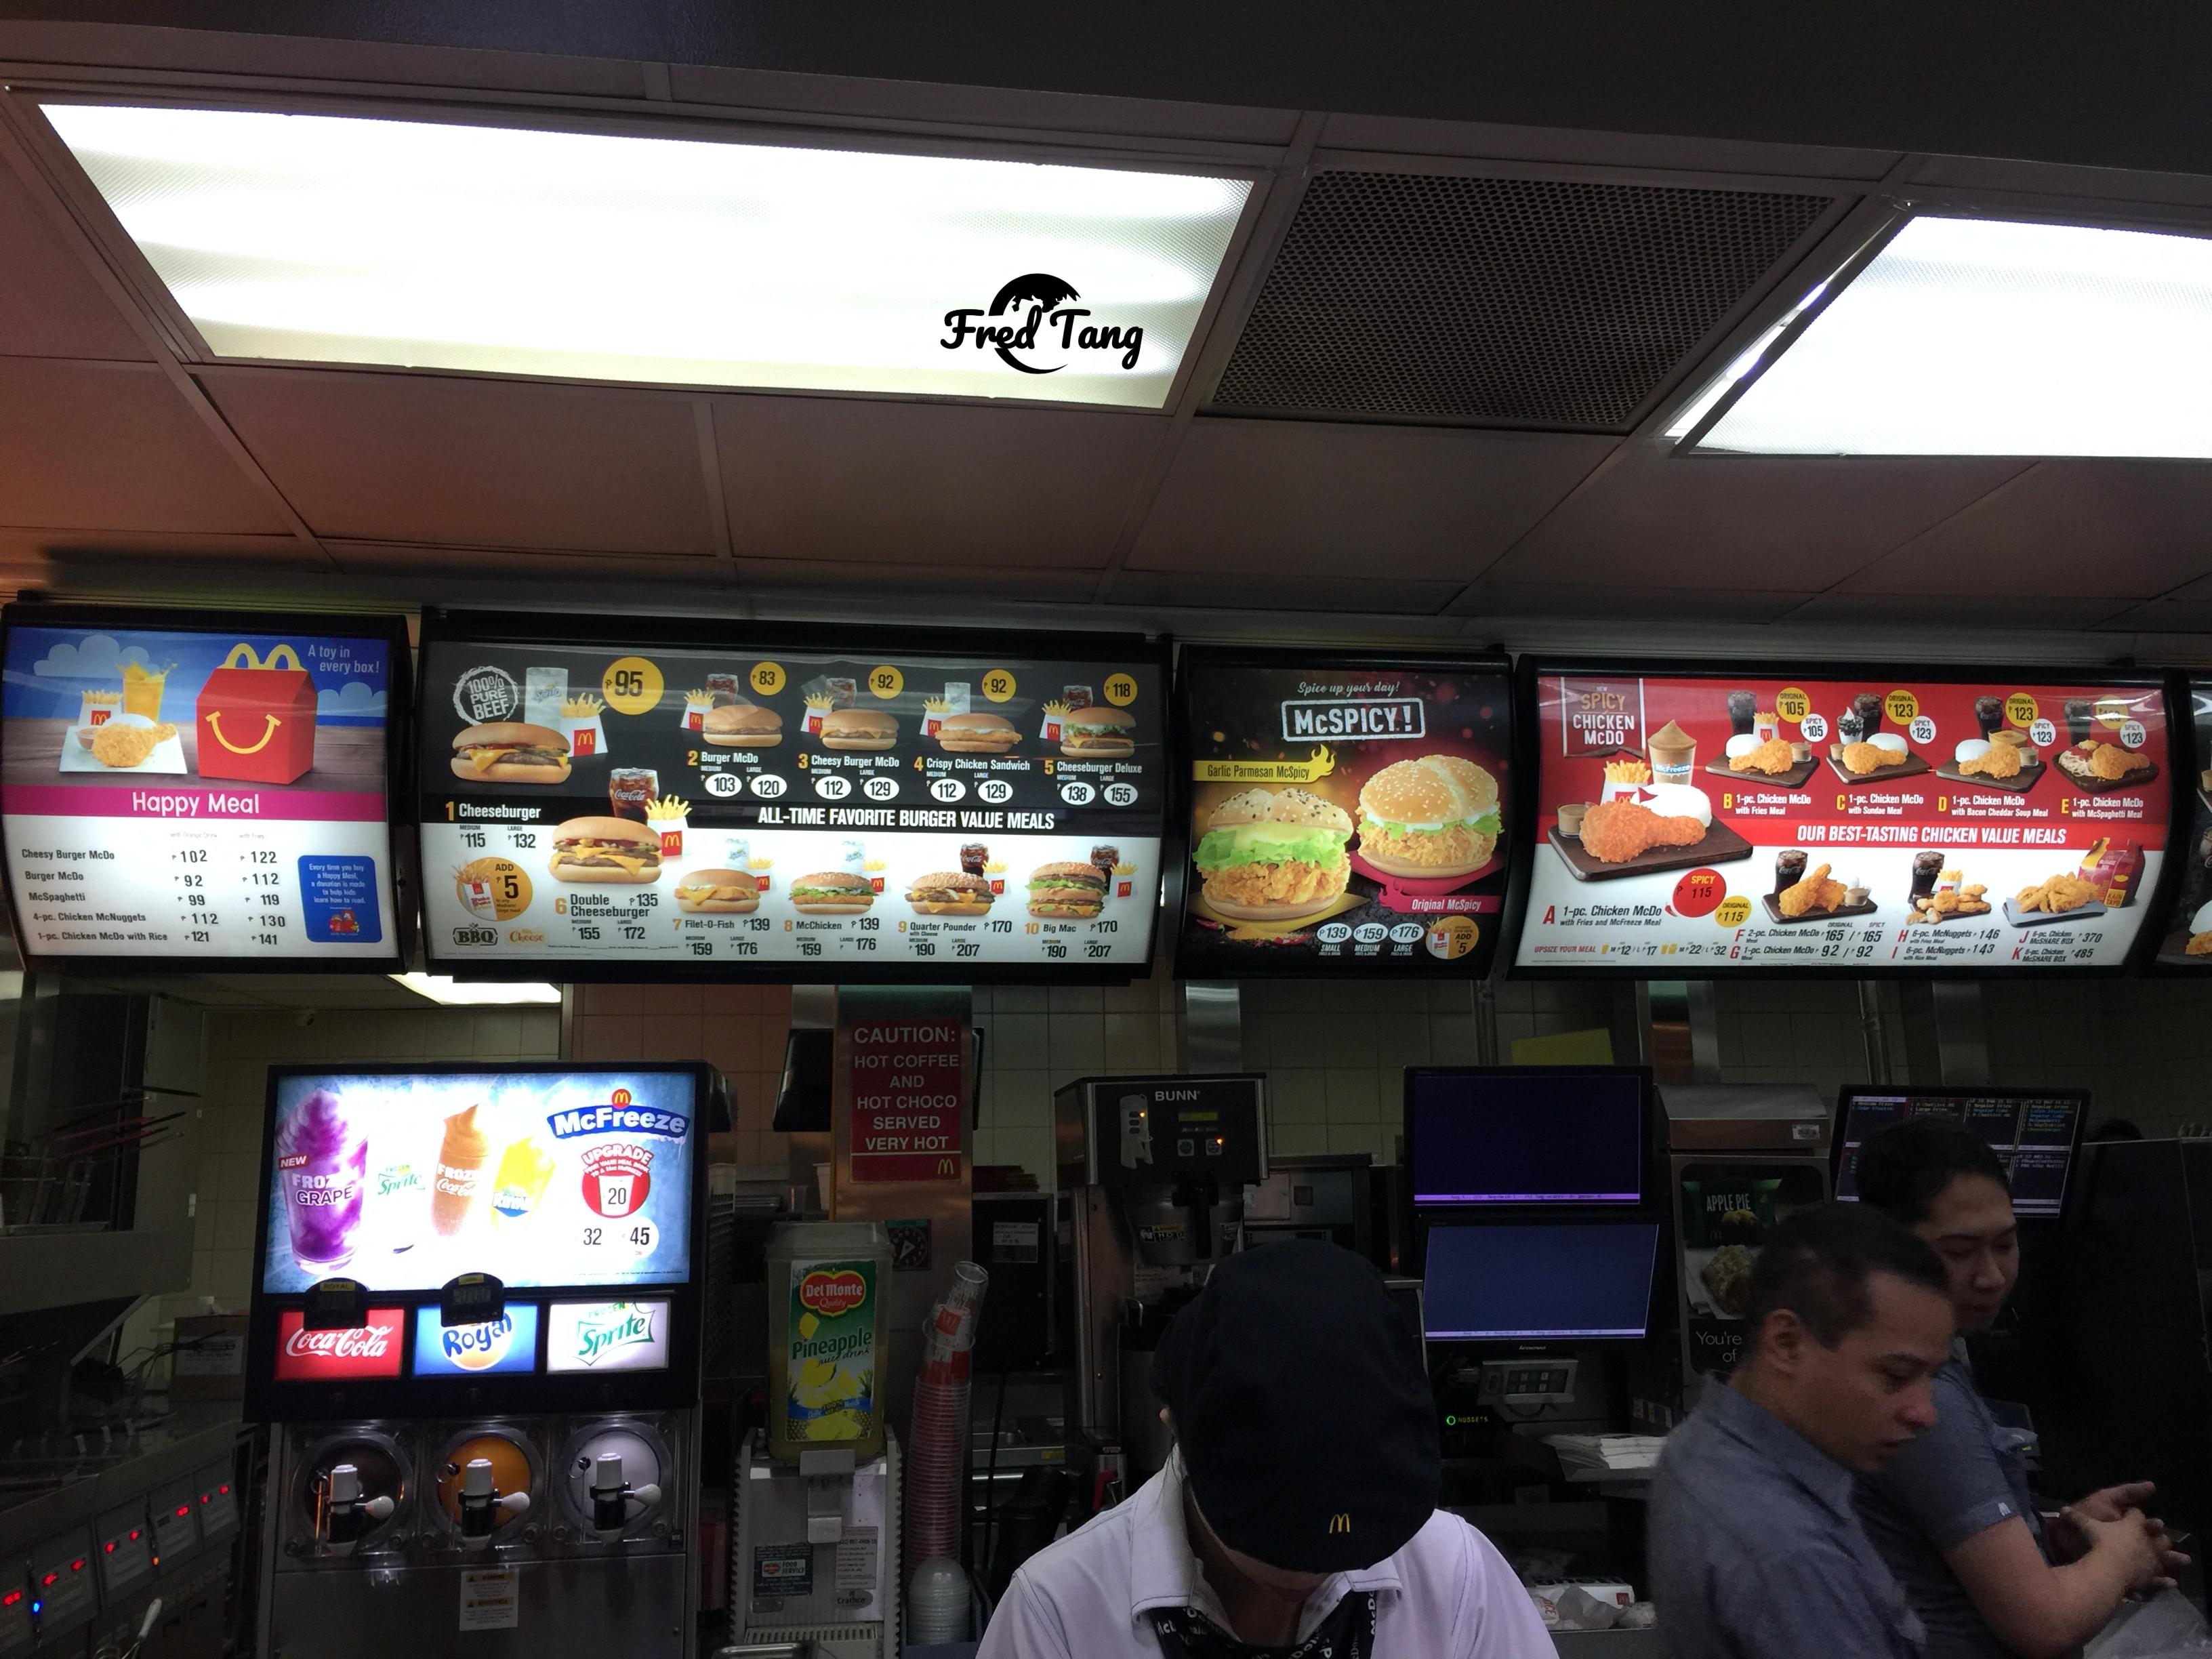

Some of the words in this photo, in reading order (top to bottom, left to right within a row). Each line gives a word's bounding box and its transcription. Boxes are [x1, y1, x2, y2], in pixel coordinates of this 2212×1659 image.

[308, 646, 315, 657] A
[318, 646, 336, 659] toy
[340, 646, 350, 657] in
[320, 661, 351, 675] every
[355, 661, 379, 674] box!
[468, 675, 504, 693] 100%
[1298, 681, 1327, 694] Spice
[1330, 683, 1343, 695] up
[1346, 682, 1372, 697] your
[1374, 681, 1399, 695] day!
[470, 689, 508, 704] PURE
[1580, 694, 1626, 712] SPICY
[1779, 693, 1807, 701] ORIGINAL
[472, 701, 509, 720] BEEF
[1573, 714, 1635, 730] CHICKEN
[701, 752, 731, 764] Burger
[733, 752, 758, 764] McDo
[812, 755, 842, 768] Cheesy
[844, 756, 872, 768] Burger
[876, 757, 899, 767] McDo
[927, 758, 953, 771] Crispy
[956, 759, 988, 770] Chicken
[991, 760, 1030, 771] Sandwich
[1057, 762, 1113, 774] Cheeseburger
[1115, 763, 1142, 773] Deluxe
[1208, 764, 1231, 778] Garlic
[1233, 765, 1273, 778] Parmesan
[1277, 767, 1309, 780] McSpicy
[132, 792, 200, 817] Happy
[209, 794, 260, 814] Meal
[1757, 794, 1787, 804] Chicken
[1789, 795, 1811, 804] McDo
[1973, 795, 2003, 806] Chicken
[2004, 796, 2024, 806] McDo
[459, 804, 541, 821] Cheeseburger
[1736, 806, 1749, 815] with
[1751, 806, 1767, 815] Fries
[1769, 806, 1786, 815] Meal
[1952, 808, 1965, 816] with
[1987, 808, 2011, 817] Cheddar
[2013, 809, 2031, 818] Soup
[758, 807, 825, 825] ALL-TIME
[830, 808, 896, 826] FAVORITE
[900, 811, 956, 827] BURGER
[960, 812, 1003, 828] VALUE
[1007, 813, 1054, 830] MEALS
[1797, 825, 1826, 841] OUR
[1829, 826, 1918, 842] BEST-TASTING
[1921, 827, 1975, 843] CHICKEN
[1982, 829, 2020, 844] VALUE
[2023, 829, 2066, 844] MEALS
[22, 849, 53, 859] Cheesy
[56, 850, 85, 861] Burger
[89, 850, 115, 859] McDo
[495, 863, 514, 872] ADD
[25, 872, 54, 881] Burger
[58, 872, 83, 880] McDo
[1691, 876, 1715, 884] SPICY
[28, 893, 85, 903] McSpaghetti
[570, 894, 609, 905] Double
[571, 905, 650, 919] Cheeseburger
[1412, 899, 1444, 911] Original
[1447, 899, 1481, 912] McSpicy
[1563, 906, 1587, 916] 1-pc.
[1591, 905, 1629, 916] Chicken
[1633, 905, 1662, 916] McDo
[33, 914, 56, 922] 4-pc.
[96, 914, 146, 923] McNuggets
[685, 920, 734, 929] Filet-O-Fish
[796, 921, 842, 930] McChicken
[910, 922, 941, 932] Quarter
[943, 922, 976, 932] Pounder
[1043, 924, 1057, 933] Big
[1059, 924, 1076, 933] Mac
[38, 933, 59, 941] 1-pc.
[100, 933, 124, 941] McDo
[127, 933, 145, 941] with
[149, 933, 167, 941] Rice
[457, 928, 494, 945] BBQ
[854, 1027, 956, 1044] CAUTION:
[854, 1056, 888, 1069] HOT
[893, 1054, 959, 1068] COFFEE
[890, 1076, 924, 1088] AND
[857, 1097, 891, 1109] HOT
[896, 1096, 957, 1109] CHOCO
[554, 1107, 685, 1136] McFreeze
[873, 1116, 940, 1130] SERVED
[865, 1137, 909, 1151] VERY
[914, 1136, 948, 1149] HOT
[280, 1156, 306, 1167] NEW
[581, 1144, 654, 1165] UPGRADE
[297, 1187, 352, 1207] GRAPE
[608, 1188, 626, 1204] 20
[1706, 1193, 1733, 1212] APPLE
[1736, 1193, 1751, 1210] PIE
[583, 1229, 602, 1245] 32
[630, 1227, 650, 1245] 45
[806, 1284, 825, 1297] Del
[826, 1284, 863, 1296] Monte
[443, 1312, 512, 1357] Royal
[577, 1314, 647, 1357] Sprite
[1696, 1331, 1742, 1346] You're
[792, 1328, 872, 1359] Pineapple
[1722, 1349, 1737, 1363] of
